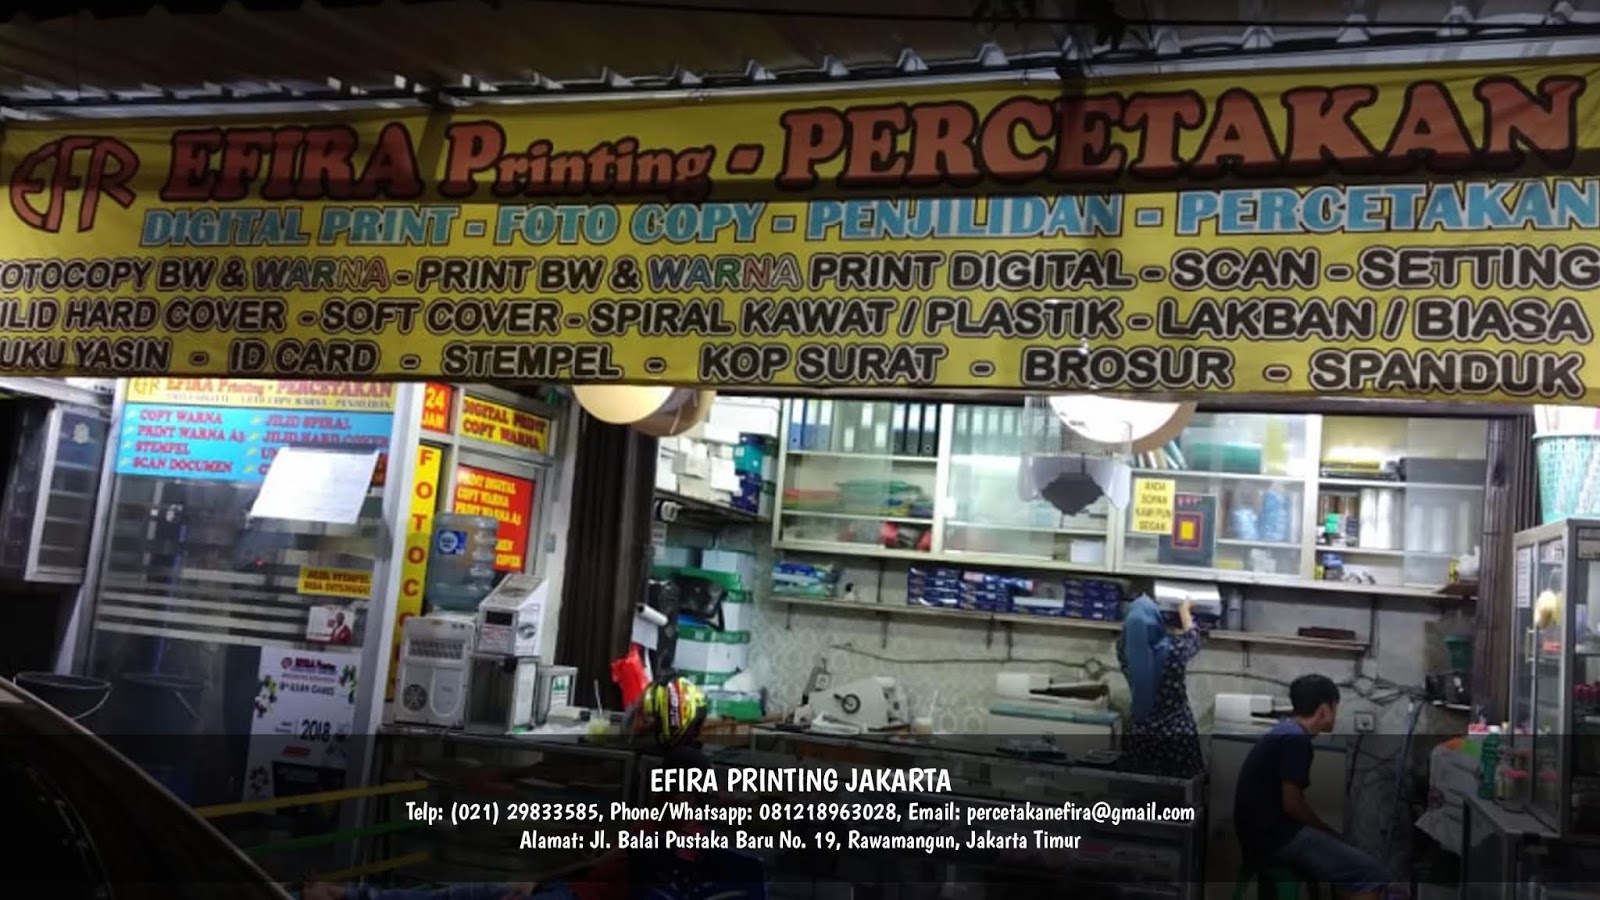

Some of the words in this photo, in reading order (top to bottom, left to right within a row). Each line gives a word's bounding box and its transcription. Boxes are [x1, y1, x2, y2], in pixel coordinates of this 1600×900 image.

[160, 122, 423, 201] EFIRA
[437, 120, 715, 197] Printing
[777, 76, 1586, 189] PERCETAKAN
[140, 207, 309, 246] DIGITAL
[317, 206, 459, 246] PRINT
[494, 202, 620, 246] FOTO
[629, 201, 765, 244] COPY
[804, 190, 1122, 240] PENJILIDAN
[1176, 179, 1600, 235] PERCETAKAN
[0, 258, 152, 292] OTOCOPY
[158, 257, 219, 291] BW
[219, 257, 247, 291] &
[254, 256, 389, 292] WARNA
[416, 257, 536, 291] PRINT
[538, 257, 604, 291] BW
[611, 257, 640, 291] &
[649, 255, 804, 290] WARNA
[809, 252, 943, 290] PRINT
[948, 251, 1136, 290] DIGITAL
[1169, 247, 1319, 289] SCAN
[1356, 246, 1600, 289] SETTING
[0, 297, 60, 332] ILID
[63, 297, 160, 332] HARD
[164, 299, 286, 333] COVER
[320, 299, 421, 334] SOFT
[425, 299, 563, 335] COVER
[589, 299, 735, 335] SPIRAL
[742, 299, 897, 336] KAWAT
[925, 299, 1124, 338] PLASTIK
[1157, 298, 1376, 340] LAKBAN
[1414, 299, 1592, 343] BIASA
[0, 336, 67, 371] UKU
[72, 336, 171, 372] YASIN
[228, 340, 270, 372] ID
[273, 339, 380, 374] CARD
[441, 341, 623, 379] STEMPEL
[699, 343, 789, 380] KOP
[795, 344, 947, 384] SURAT
[1021, 347, 1235, 389] BROSUR
[1308, 348, 1587, 398] SPANDUK
[425, 387, 445, 408] 24
[140, 409, 171, 422] COPY
[177, 410, 223, 424] WARNA
[422, 411, 444, 429] JAM
[138, 425, 176, 438] PRINT
[180, 426, 225, 440] WARNA
[463, 418, 495, 438] COPY
[136, 441, 190, 454] STEMPEL
[133, 456, 166, 469] SCAN
[301, 720, 331, 742] 2018
